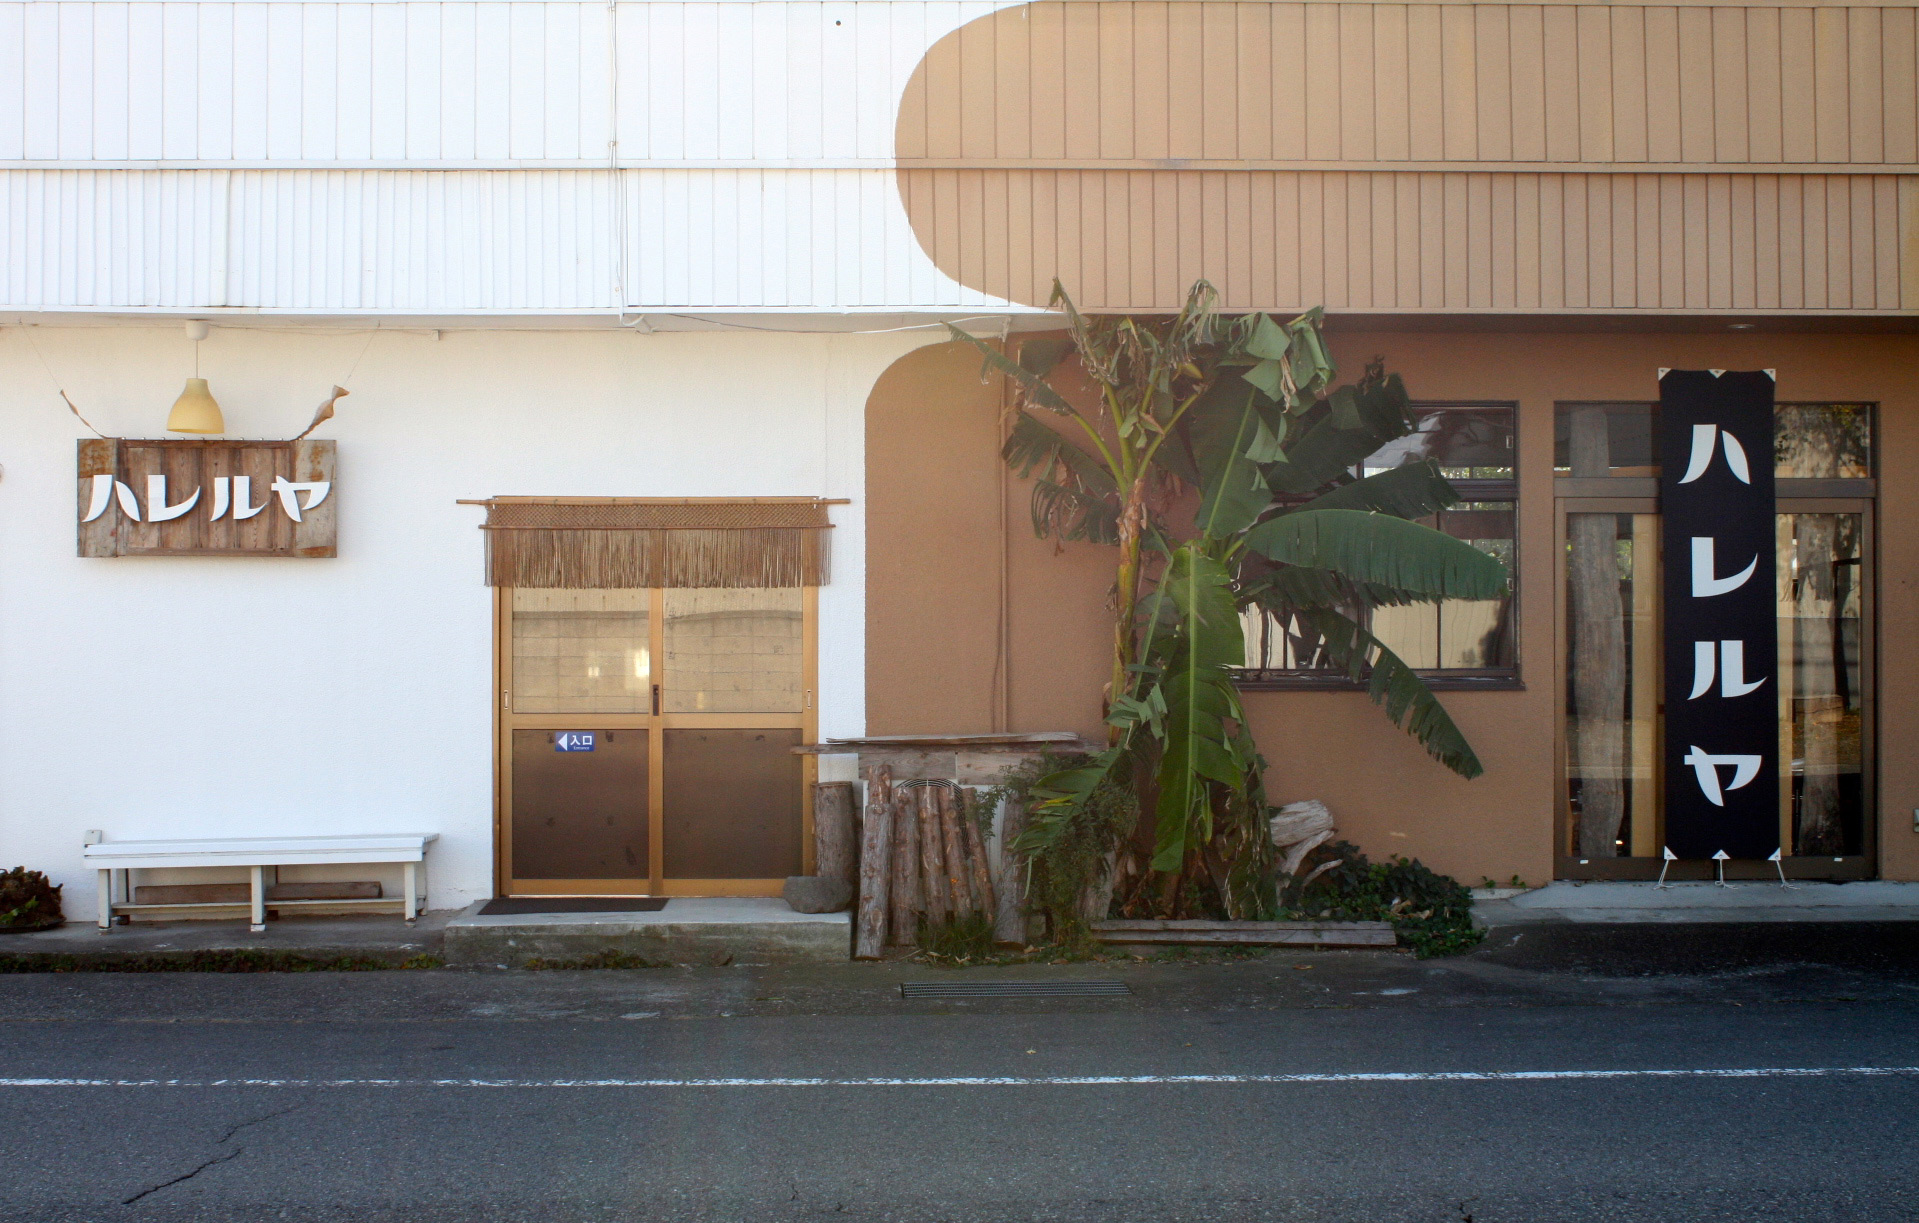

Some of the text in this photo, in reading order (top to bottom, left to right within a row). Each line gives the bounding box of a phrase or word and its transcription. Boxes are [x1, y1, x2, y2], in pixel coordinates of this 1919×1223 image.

[81, 474, 330, 522] ハレルヤ
[1677, 424, 1767, 807] ハレルヤ
[570, 735, 592, 746] 入口
